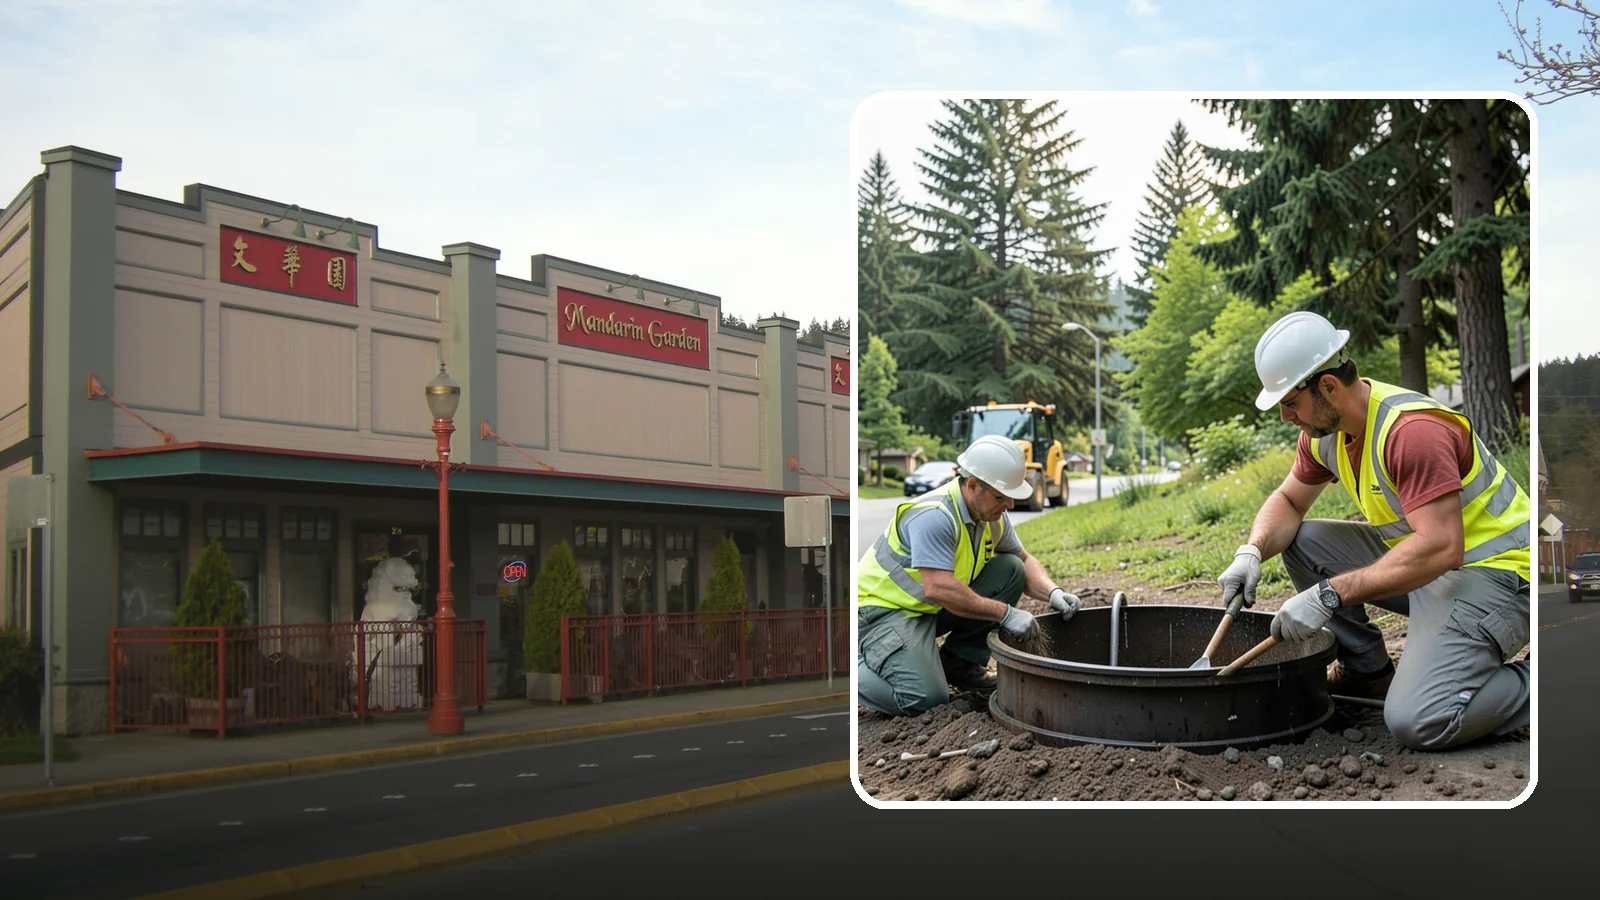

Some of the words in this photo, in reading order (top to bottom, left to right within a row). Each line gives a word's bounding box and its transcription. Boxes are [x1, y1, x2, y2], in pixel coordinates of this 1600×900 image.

[564, 302, 644, 341] Mandarin
[648, 320, 701, 352] Garden
[503, 565, 527, 578] OPEN
